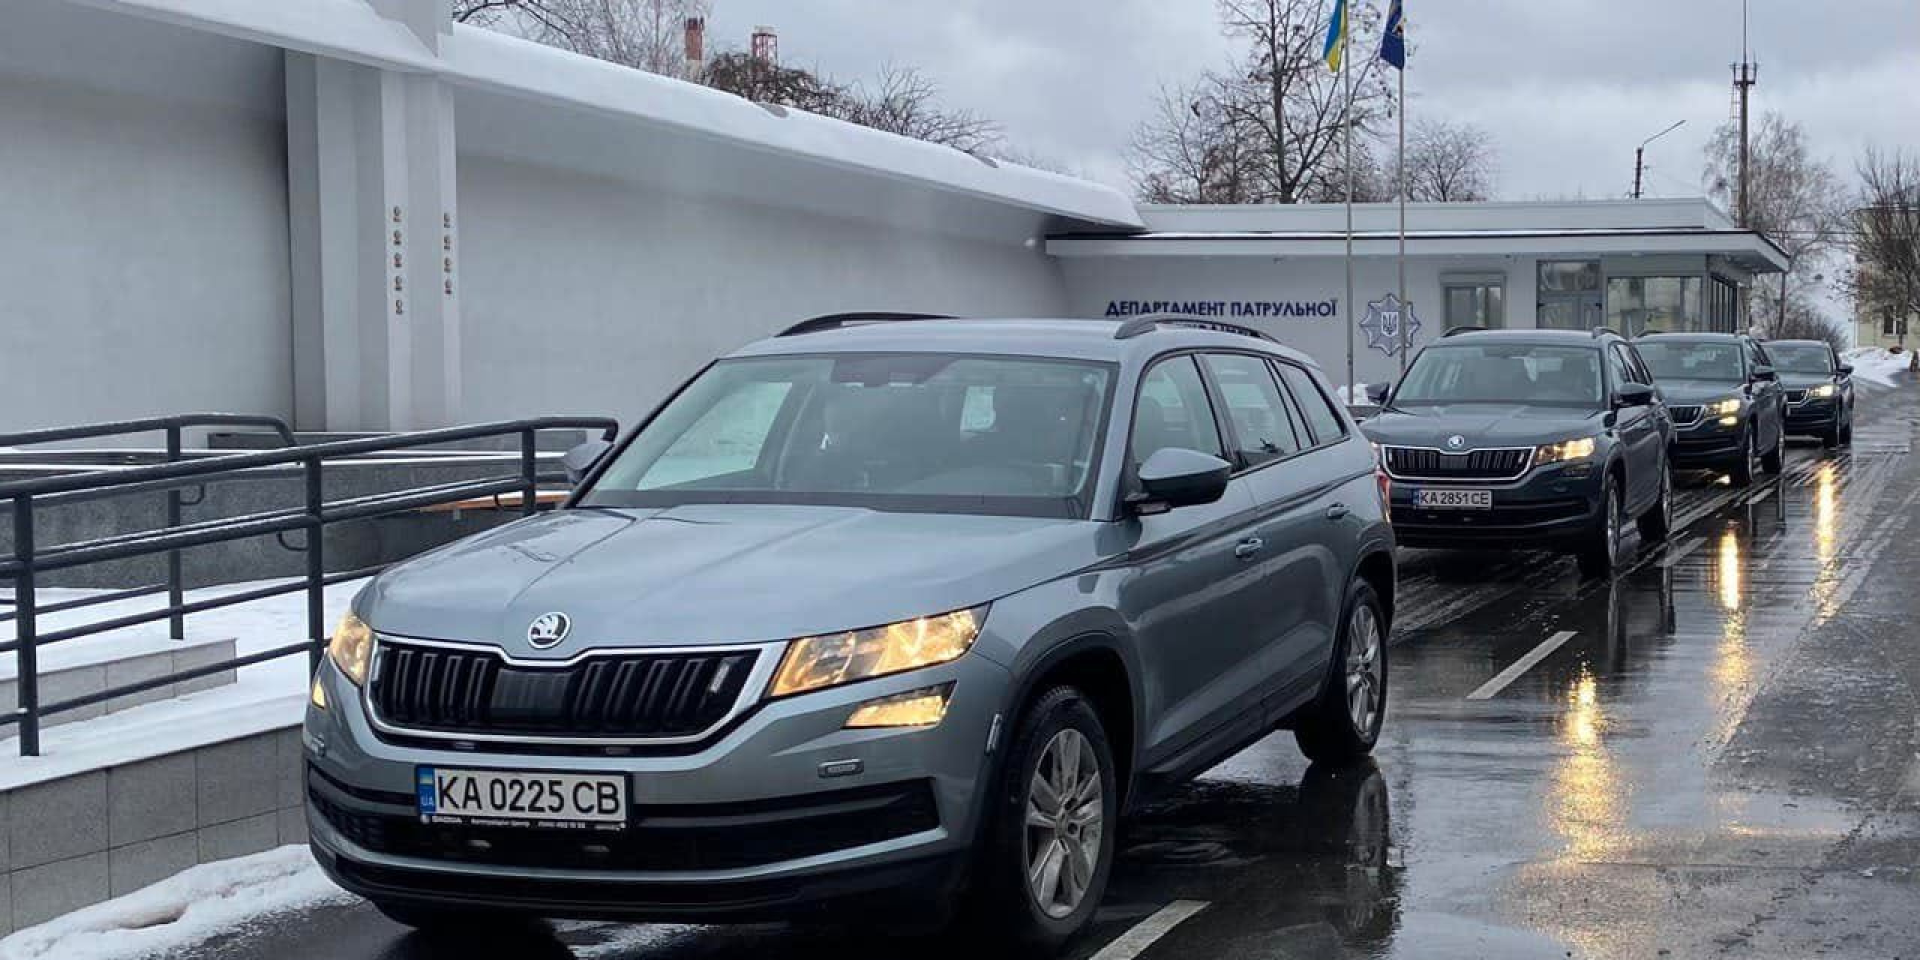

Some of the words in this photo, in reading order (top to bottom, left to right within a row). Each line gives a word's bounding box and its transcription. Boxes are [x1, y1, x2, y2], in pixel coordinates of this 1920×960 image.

[1105, 300, 1225, 317] ДЕПАРТАМЕНТ
[1230, 299, 1338, 317] ПАТРУЛЬНОЇ
[420, 795, 434, 806] UA
[437, 775, 483, 811] KA
[489, 777, 566, 815] 0225
[571, 780, 620, 815] CB
